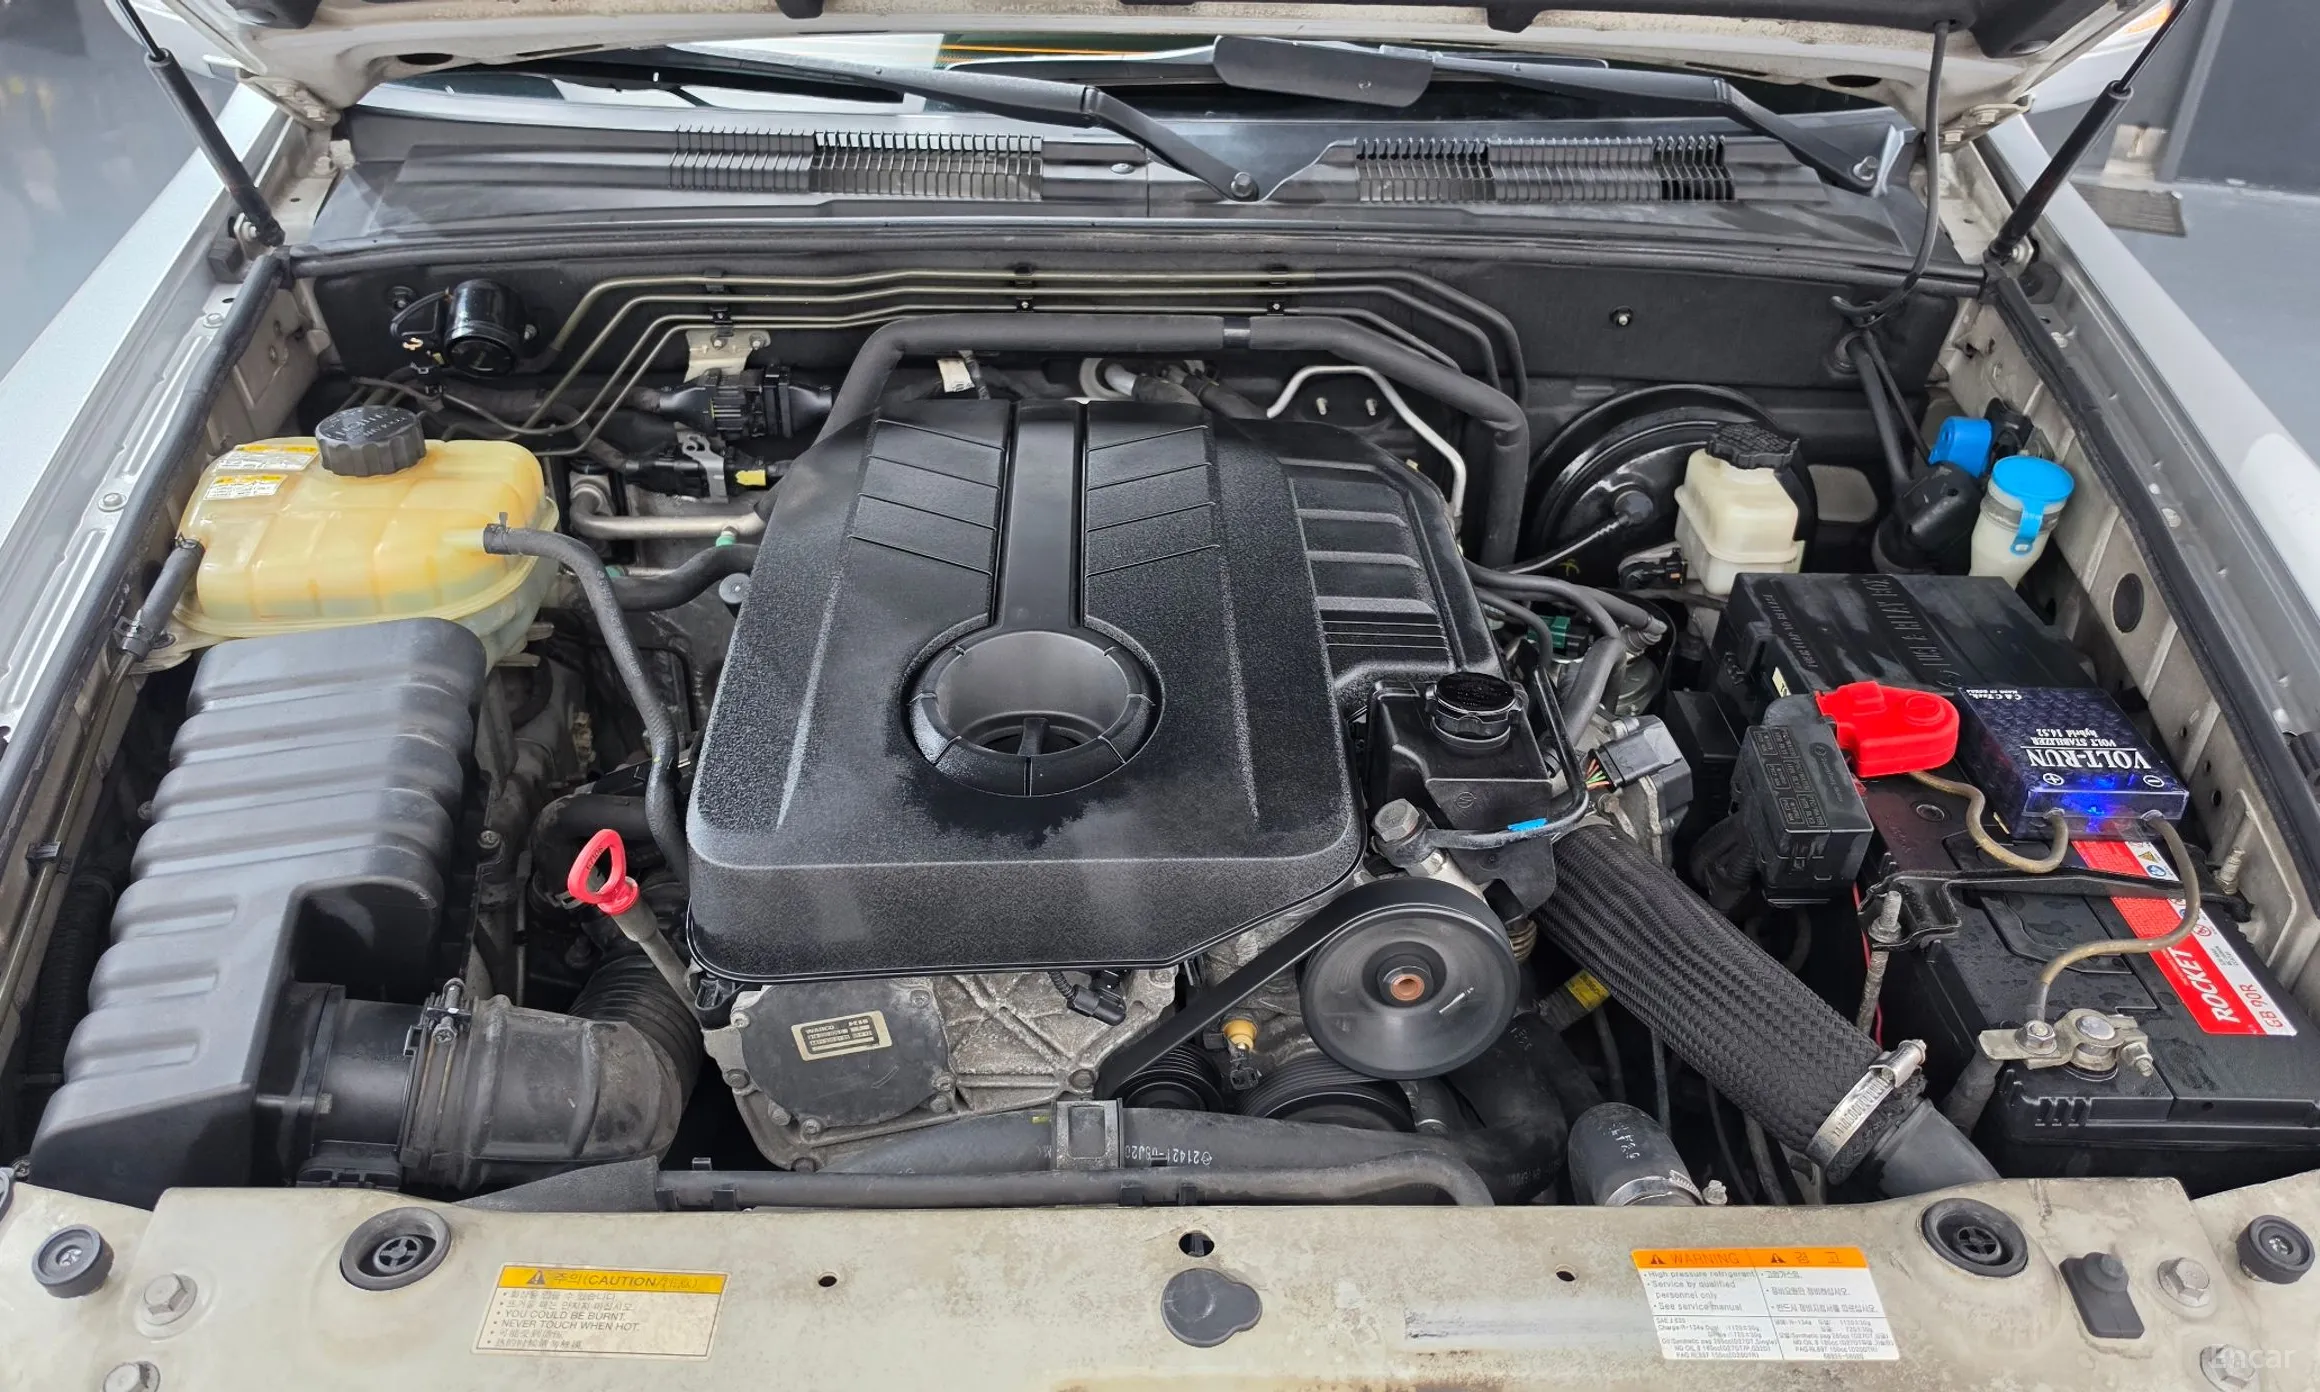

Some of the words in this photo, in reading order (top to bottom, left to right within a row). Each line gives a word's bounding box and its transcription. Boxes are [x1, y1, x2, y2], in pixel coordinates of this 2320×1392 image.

[2031, 736, 2087, 747] STABILIZER
[2089, 738, 2116, 748] VOLT
[2025, 748, 2151, 769] VOLT-RUN
[2166, 946, 2240, 1023] ROCKET
[2260, 1010, 2284, 1028] GB
[1671, 1252, 1740, 1265] WARNING
[1825, 1251, 1843, 1264] 고
[1648, 1271, 1668, 1279] High
[1709, 1271, 1756, 1279] refrigerant
[1652, 1280, 1684, 1288] Service
[1687, 1280, 1697, 1289] by
[1699, 1280, 1736, 1289] qualified
[1655, 1291, 1698, 1300] personnel
[1700, 1291, 1718, 1300] only
[1659, 1303, 1675, 1311] See
[1677, 1303, 1711, 1311] service
[1711, 1303, 1743, 1311] manual
[505, 1310, 529, 1319] YOU
[530, 1310, 567, 1320] COULD
[570, 1311, 585, 1320] BE
[587, 1312, 626, 1321] BURNT.
[501, 1318, 537, 1329] NEVER
[539, 1320, 578, 1330] TOUCH
[580, 1321, 613, 1331] WHEN
[615, 1322, 640, 1332] HOT.
